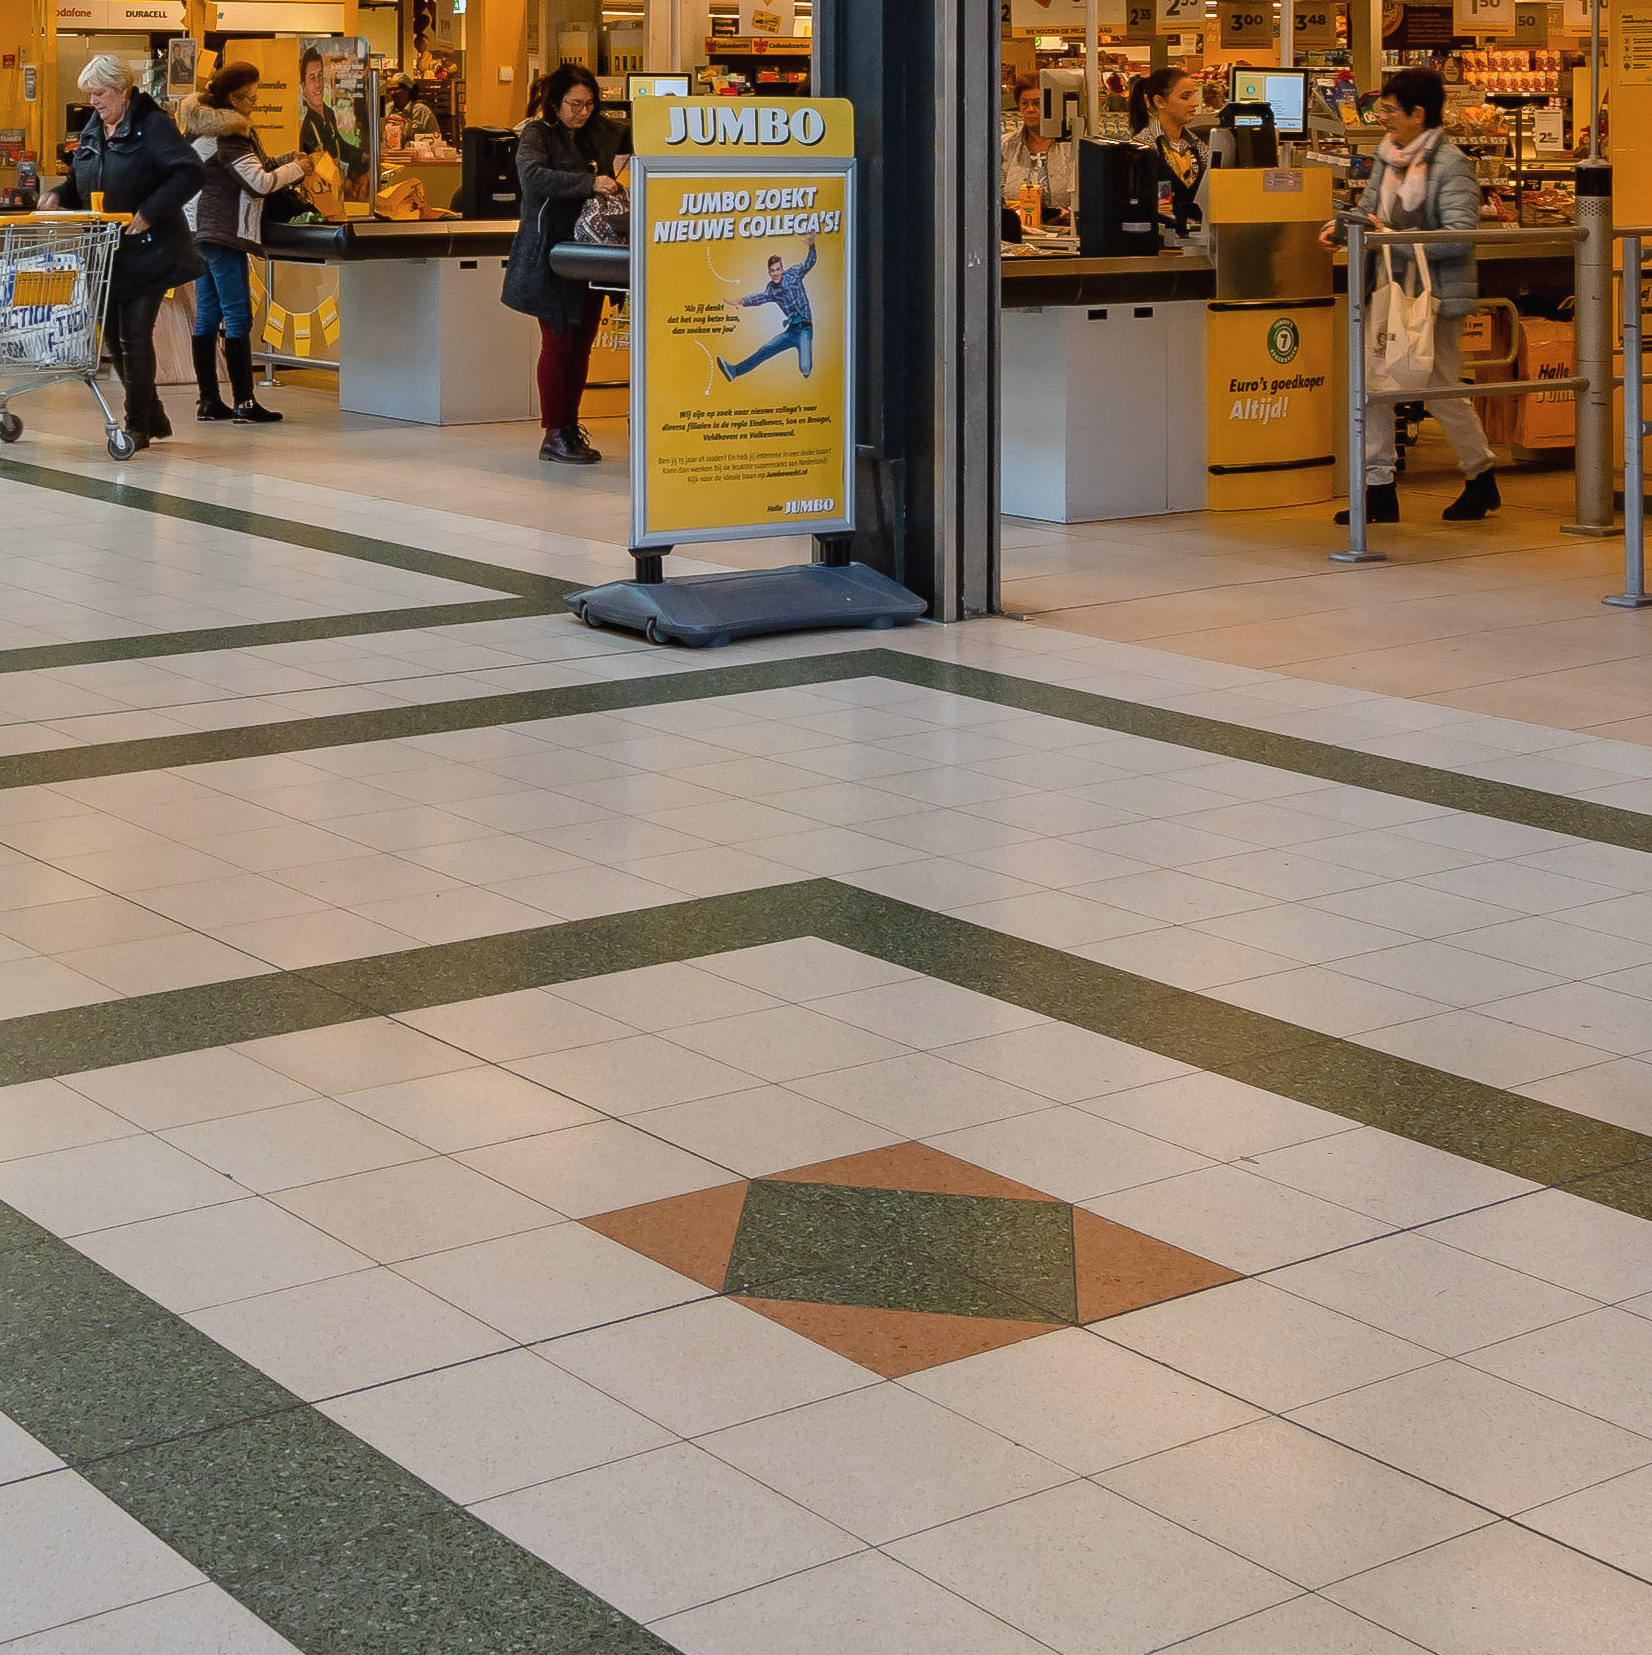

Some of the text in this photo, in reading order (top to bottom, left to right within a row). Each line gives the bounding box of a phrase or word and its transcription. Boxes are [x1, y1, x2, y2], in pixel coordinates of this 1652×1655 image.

[126, 10, 168, 18] DURACELL
[1231, 14, 1264, 31] 300
[1295, 14, 1326, 31] 348
[665, 107, 825, 146] JUMBO
[679, 186, 817, 216] JUMBO ZOEKT
[653, 210, 840, 243] NIEUWE COLLEGA'S!
[705, 304, 725, 312] denkt
[667, 315, 678, 324] dat
[679, 315, 691, 324] het
[693, 316, 706, 326] nog
[672, 325, 684, 334] dan
[712, 325, 721, 334] we
[1280, 333, 1289, 348] 7
[1538, 362, 1569, 379] Hallo
[1229, 374, 1325, 394] Euro's goedkoper
[679, 410, 691, 420] Wij
[1229, 397, 1289, 424] Altijd!
[784, 498, 835, 515] JUMBO
